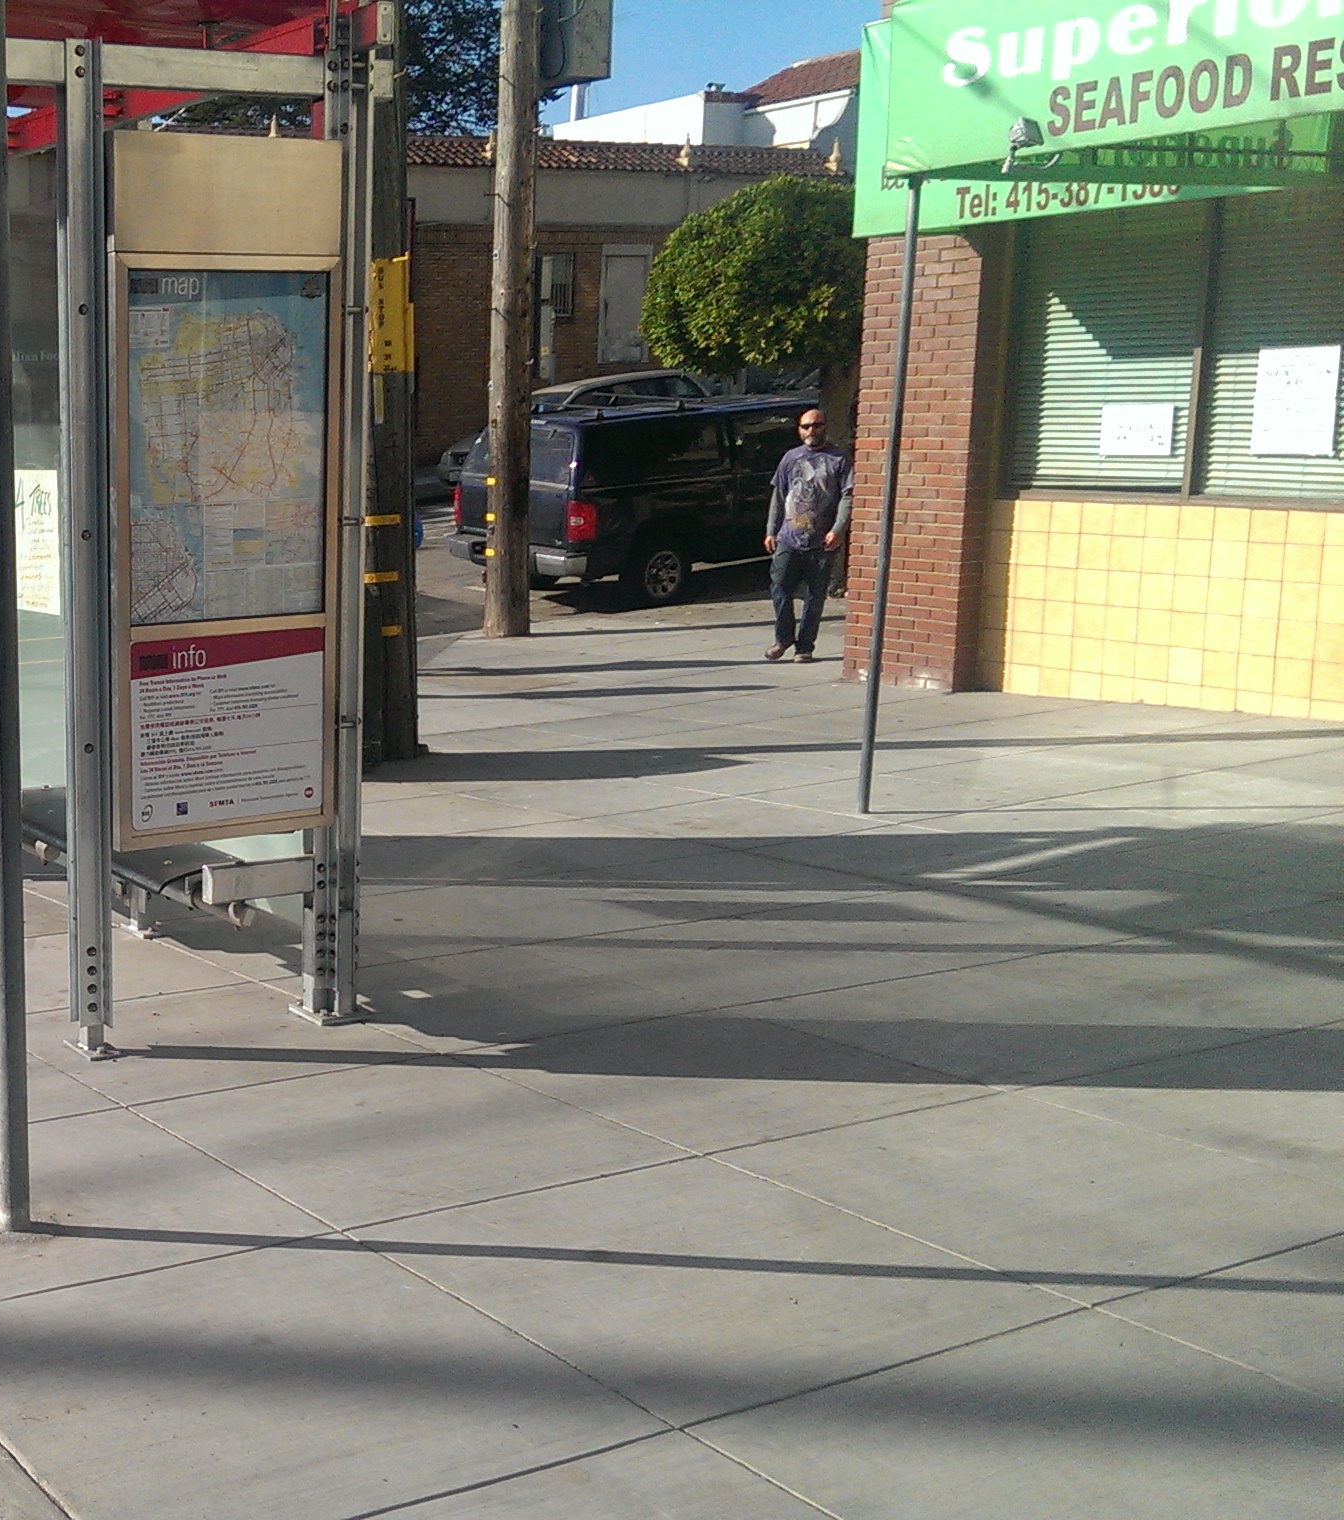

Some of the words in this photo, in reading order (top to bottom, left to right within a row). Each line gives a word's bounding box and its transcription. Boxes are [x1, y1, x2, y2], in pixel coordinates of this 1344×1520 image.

[1047, 53, 1254, 138] SEAFOOD
[956, 184, 998, 219] Tel:
[161, 275, 200, 300] map
[171, 643, 207, 669] info
